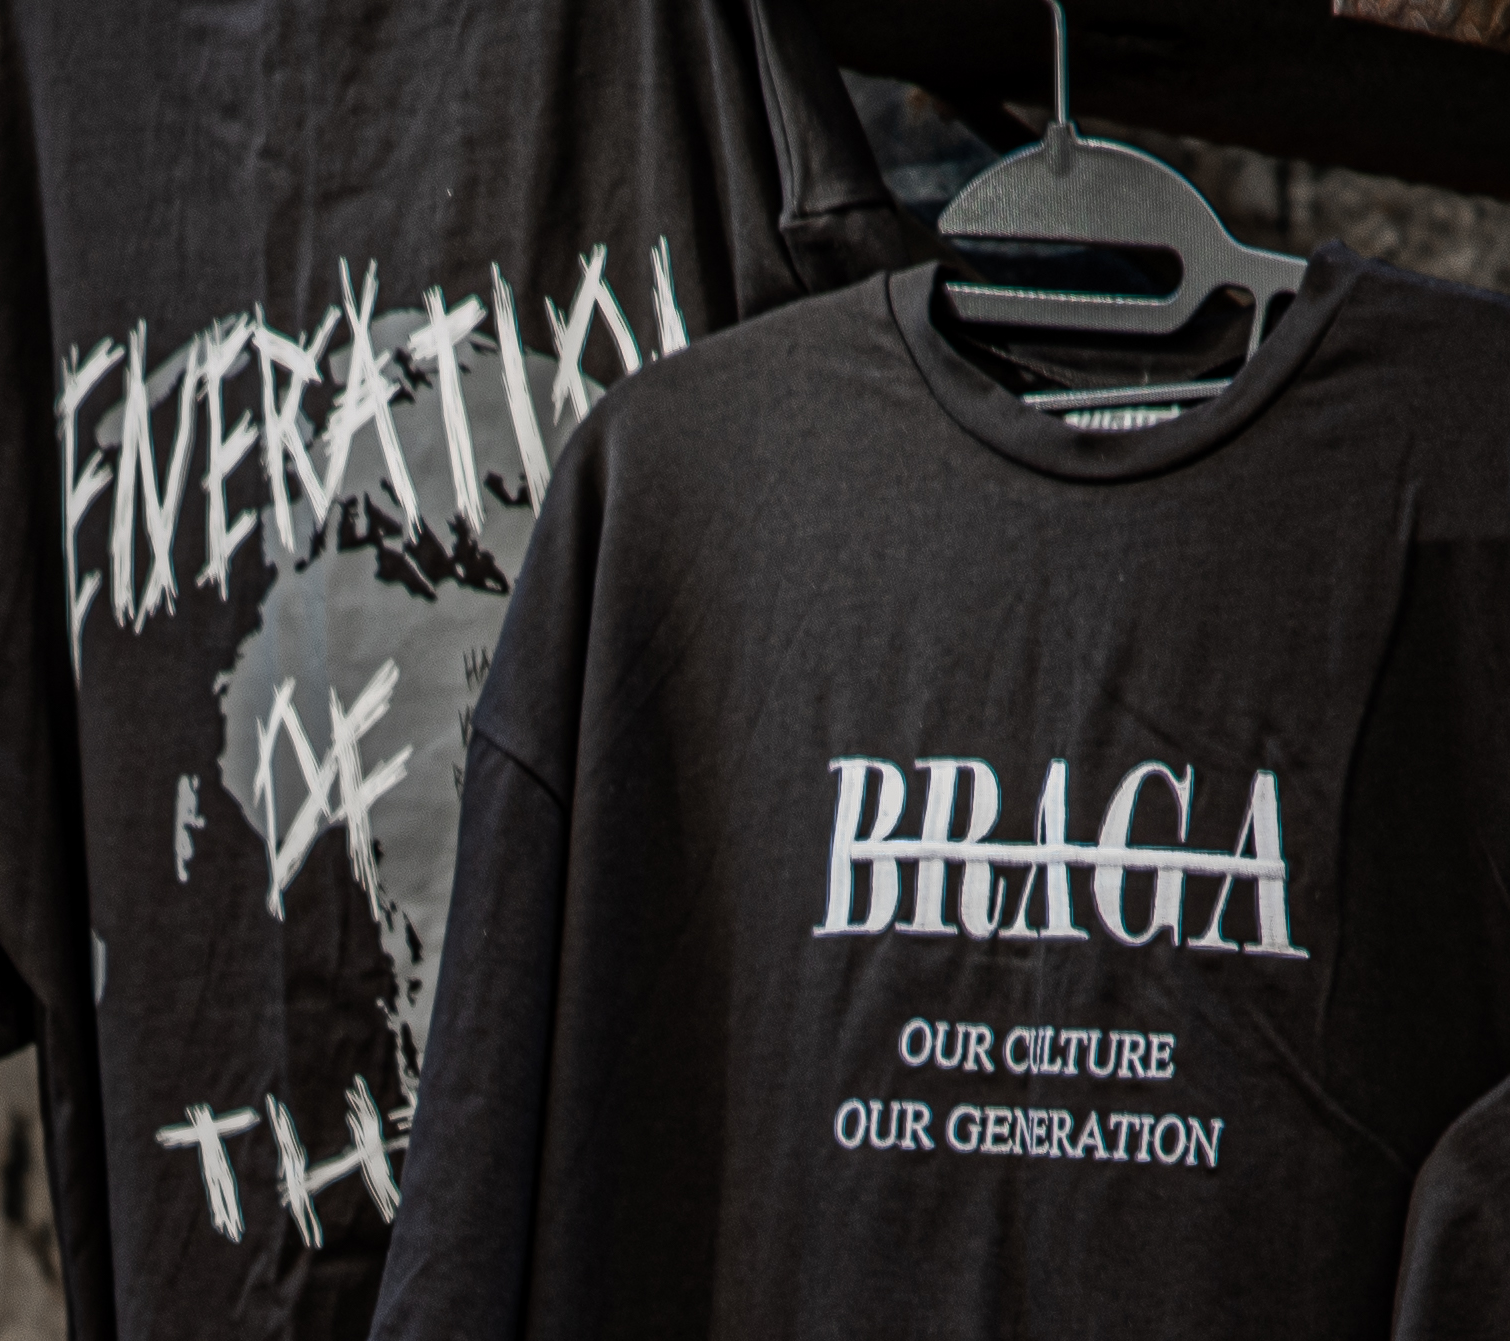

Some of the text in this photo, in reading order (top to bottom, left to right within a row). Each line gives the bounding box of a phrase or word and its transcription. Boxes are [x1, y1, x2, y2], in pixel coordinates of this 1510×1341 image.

[811, 755, 1310, 960] BRAGA
[899, 1017, 1177, 1079] OUR CULTURE
[155, 1074, 416, 1250] TH
[834, 1097, 1223, 1168] OUR GENERATION
